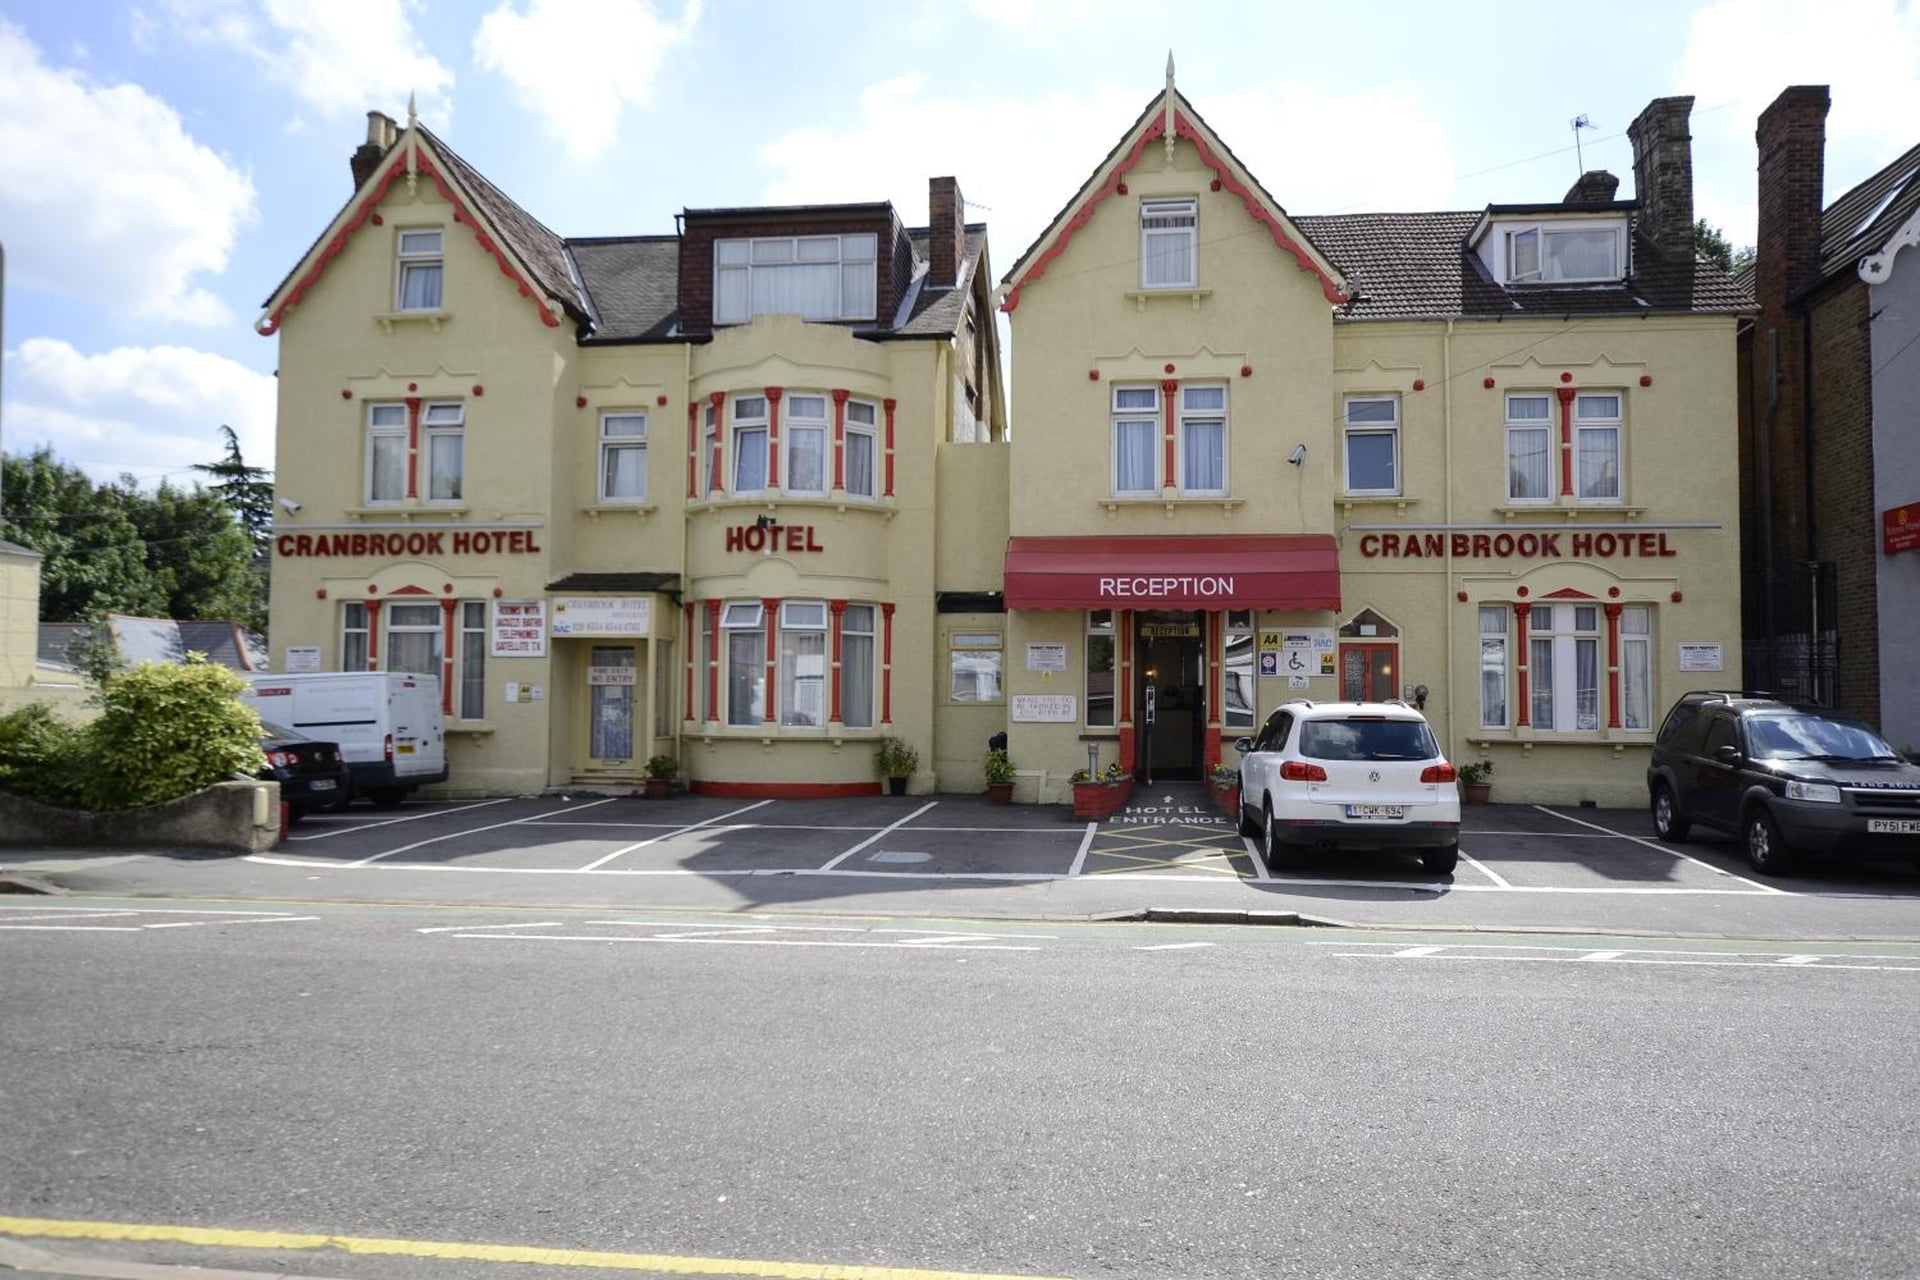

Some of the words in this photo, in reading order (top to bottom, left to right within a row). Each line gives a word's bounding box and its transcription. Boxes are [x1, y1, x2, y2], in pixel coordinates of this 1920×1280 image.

[277, 532, 444, 557] CRANBROOK
[453, 530, 541, 554] HOTEL
[726, 525, 823, 552] HOTEL
[1360, 533, 1561, 558] CRANBROOK
[1572, 533, 1676, 558] HOTEL
[1100, 577, 1234, 596] RECEPTION
[1263, 635, 1278, 644] AA
[592, 675, 602, 683] NO
[606, 675, 633, 683] ENTRY
[1125, 806, 1207, 814] HOTEL
[1109, 816, 1227, 824] ENTRANCE
[1875, 821, 1899, 832] PY51
